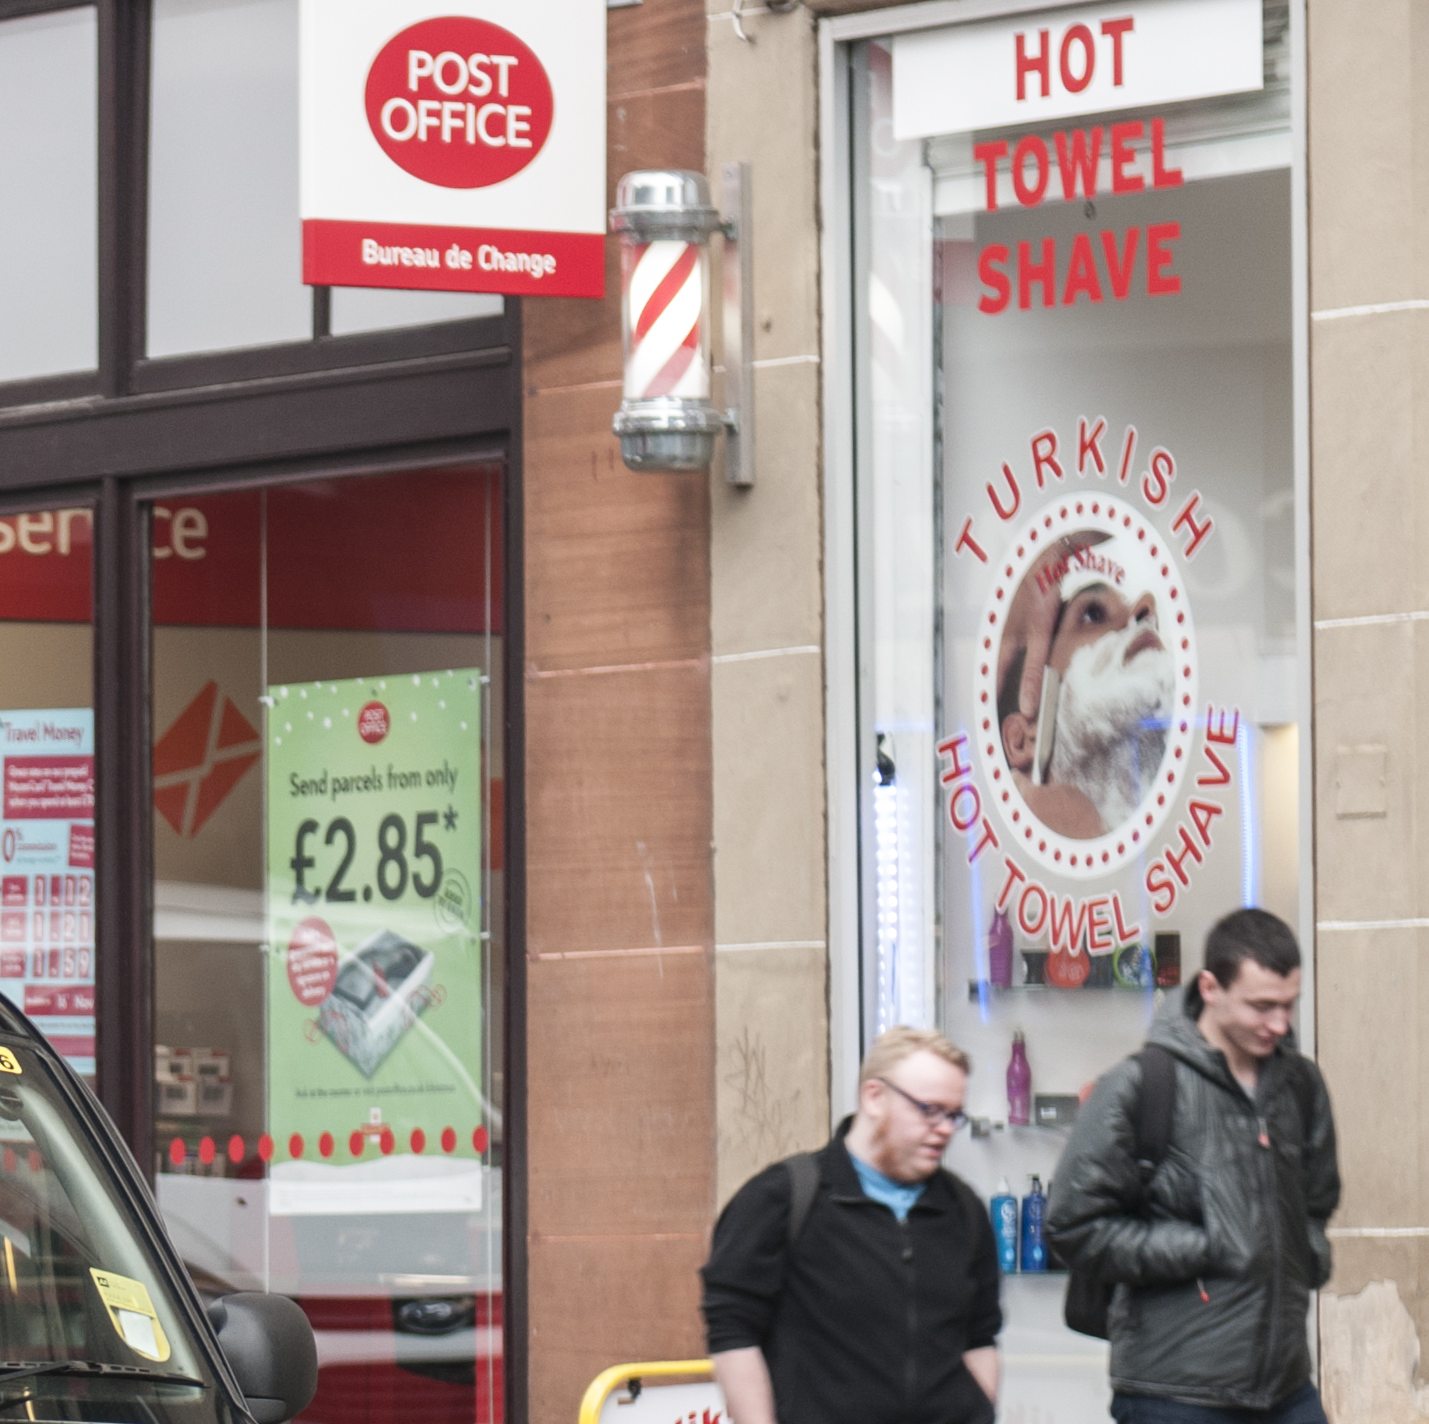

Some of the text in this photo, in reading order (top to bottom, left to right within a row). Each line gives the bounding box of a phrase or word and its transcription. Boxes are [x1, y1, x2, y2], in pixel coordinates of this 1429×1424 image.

[408, 49, 519, 97] POST
[1014, 16, 1135, 102] HOT
[381, 97, 532, 148] OFFICE
[973, 117, 1184, 212] TOWEL
[362, 239, 557, 278] Bureau de Change
[977, 222, 1182, 316] SHAVE
[955, 419, 1213, 563] TURKISH
[1034, 545, 1126, 594] Hot Shave
[5, 720, 84, 749] Travel Money
[290, 758, 459, 801] Send parcels from only
[938, 706, 1239, 950] HOT TOWEL SHAVE
